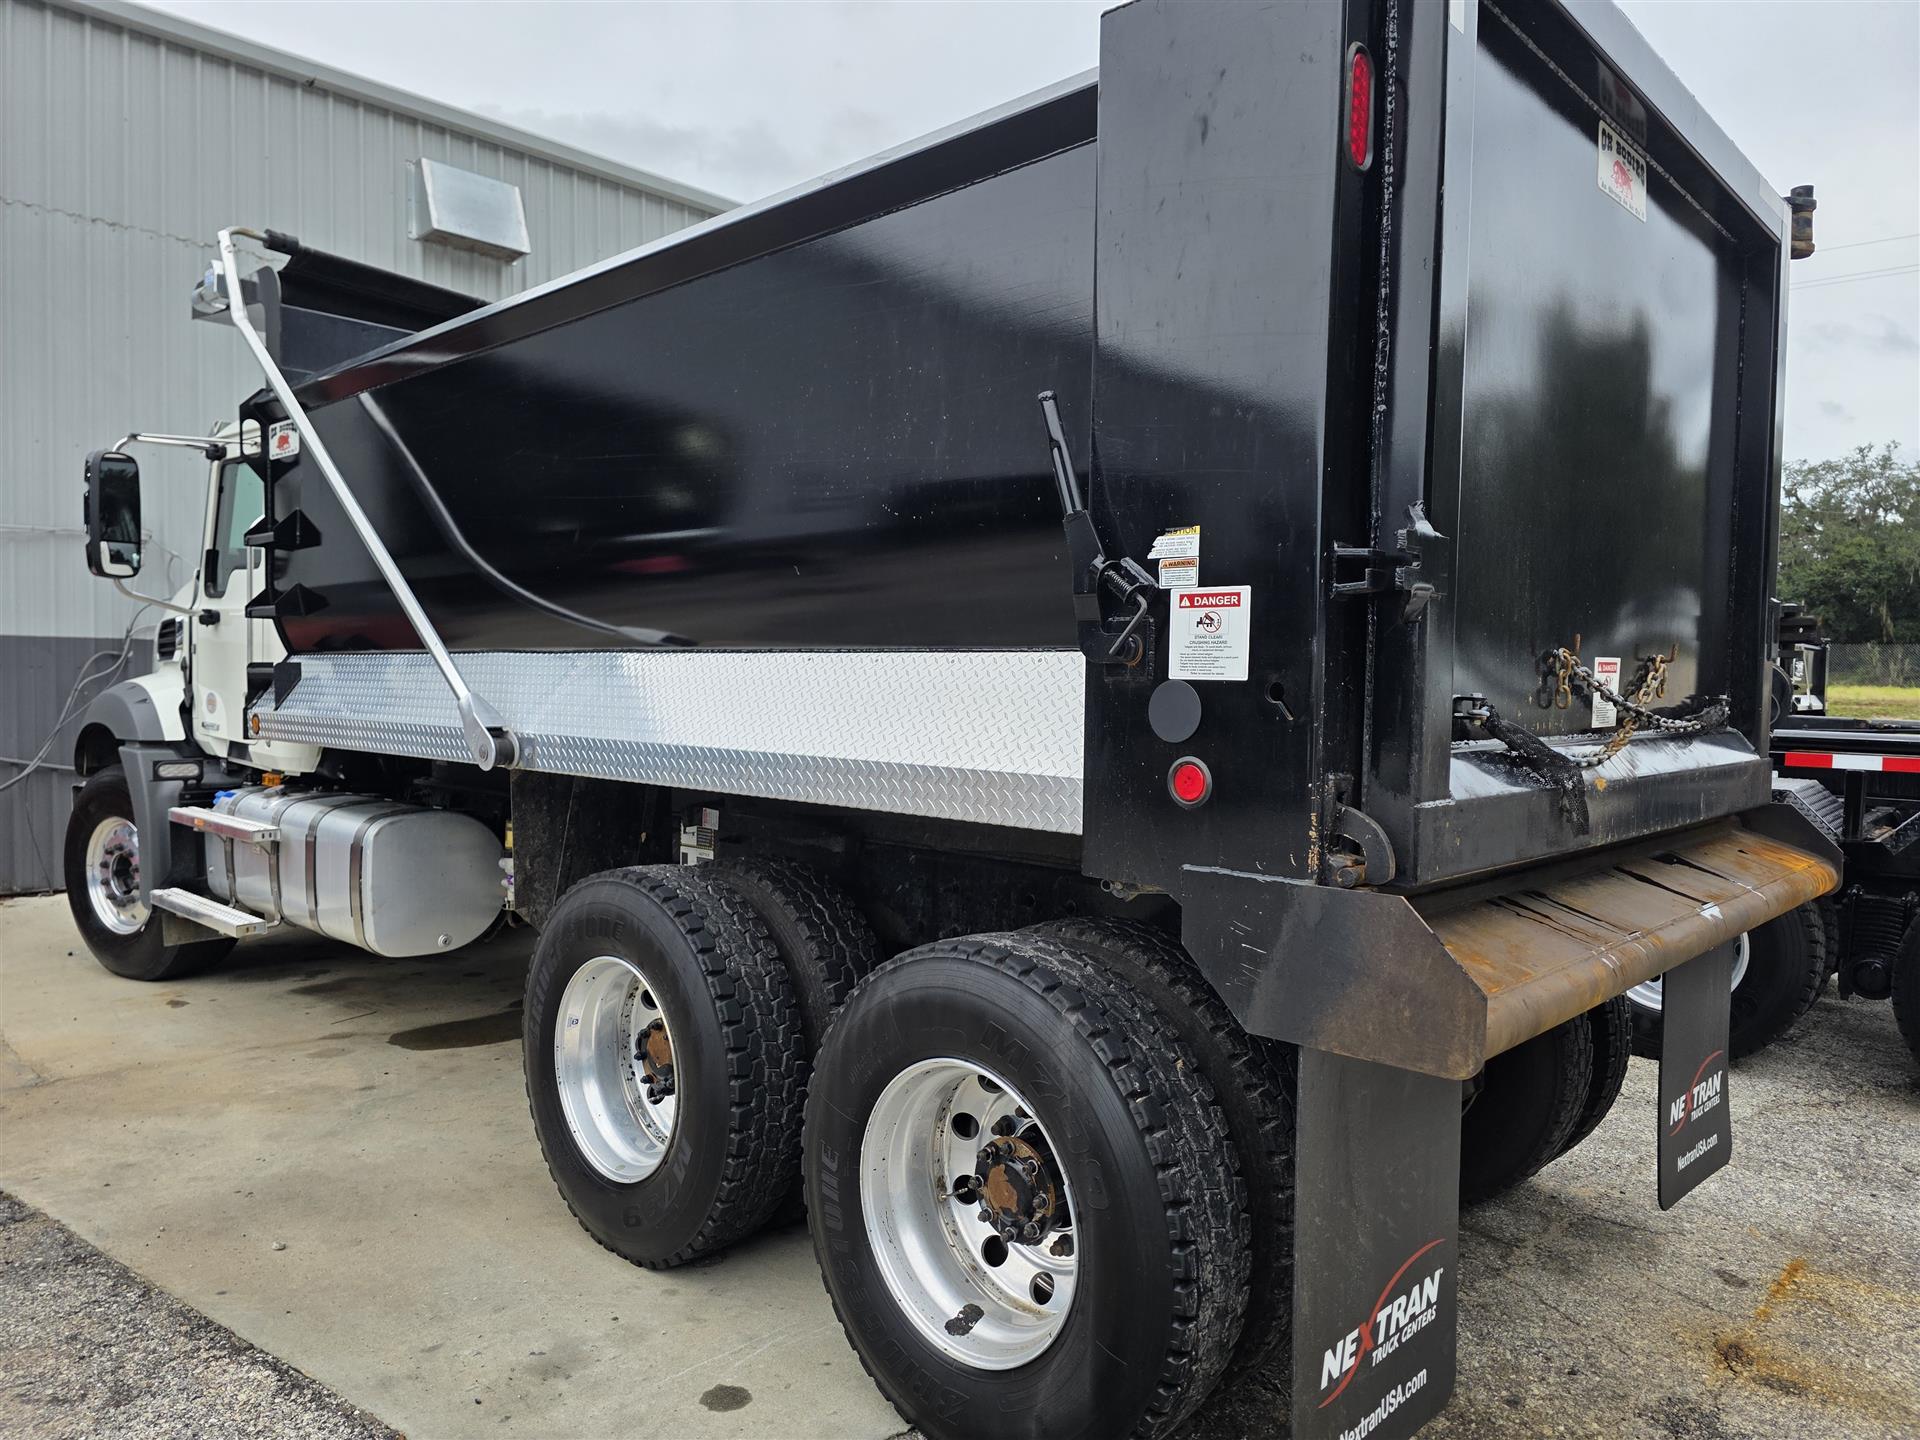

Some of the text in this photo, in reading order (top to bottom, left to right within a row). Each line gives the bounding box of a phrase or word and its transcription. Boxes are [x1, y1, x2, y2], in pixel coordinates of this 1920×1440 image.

[1194, 595, 1239, 606] DANGER
[1670, 1070, 1723, 1126] NEXTRAN
[1677, 1133, 1718, 1172] NextranUSA.com
[1320, 1269, 1442, 1391] NEXTRAN
[1372, 1304, 1437, 1367] TRUCK CENTERS
